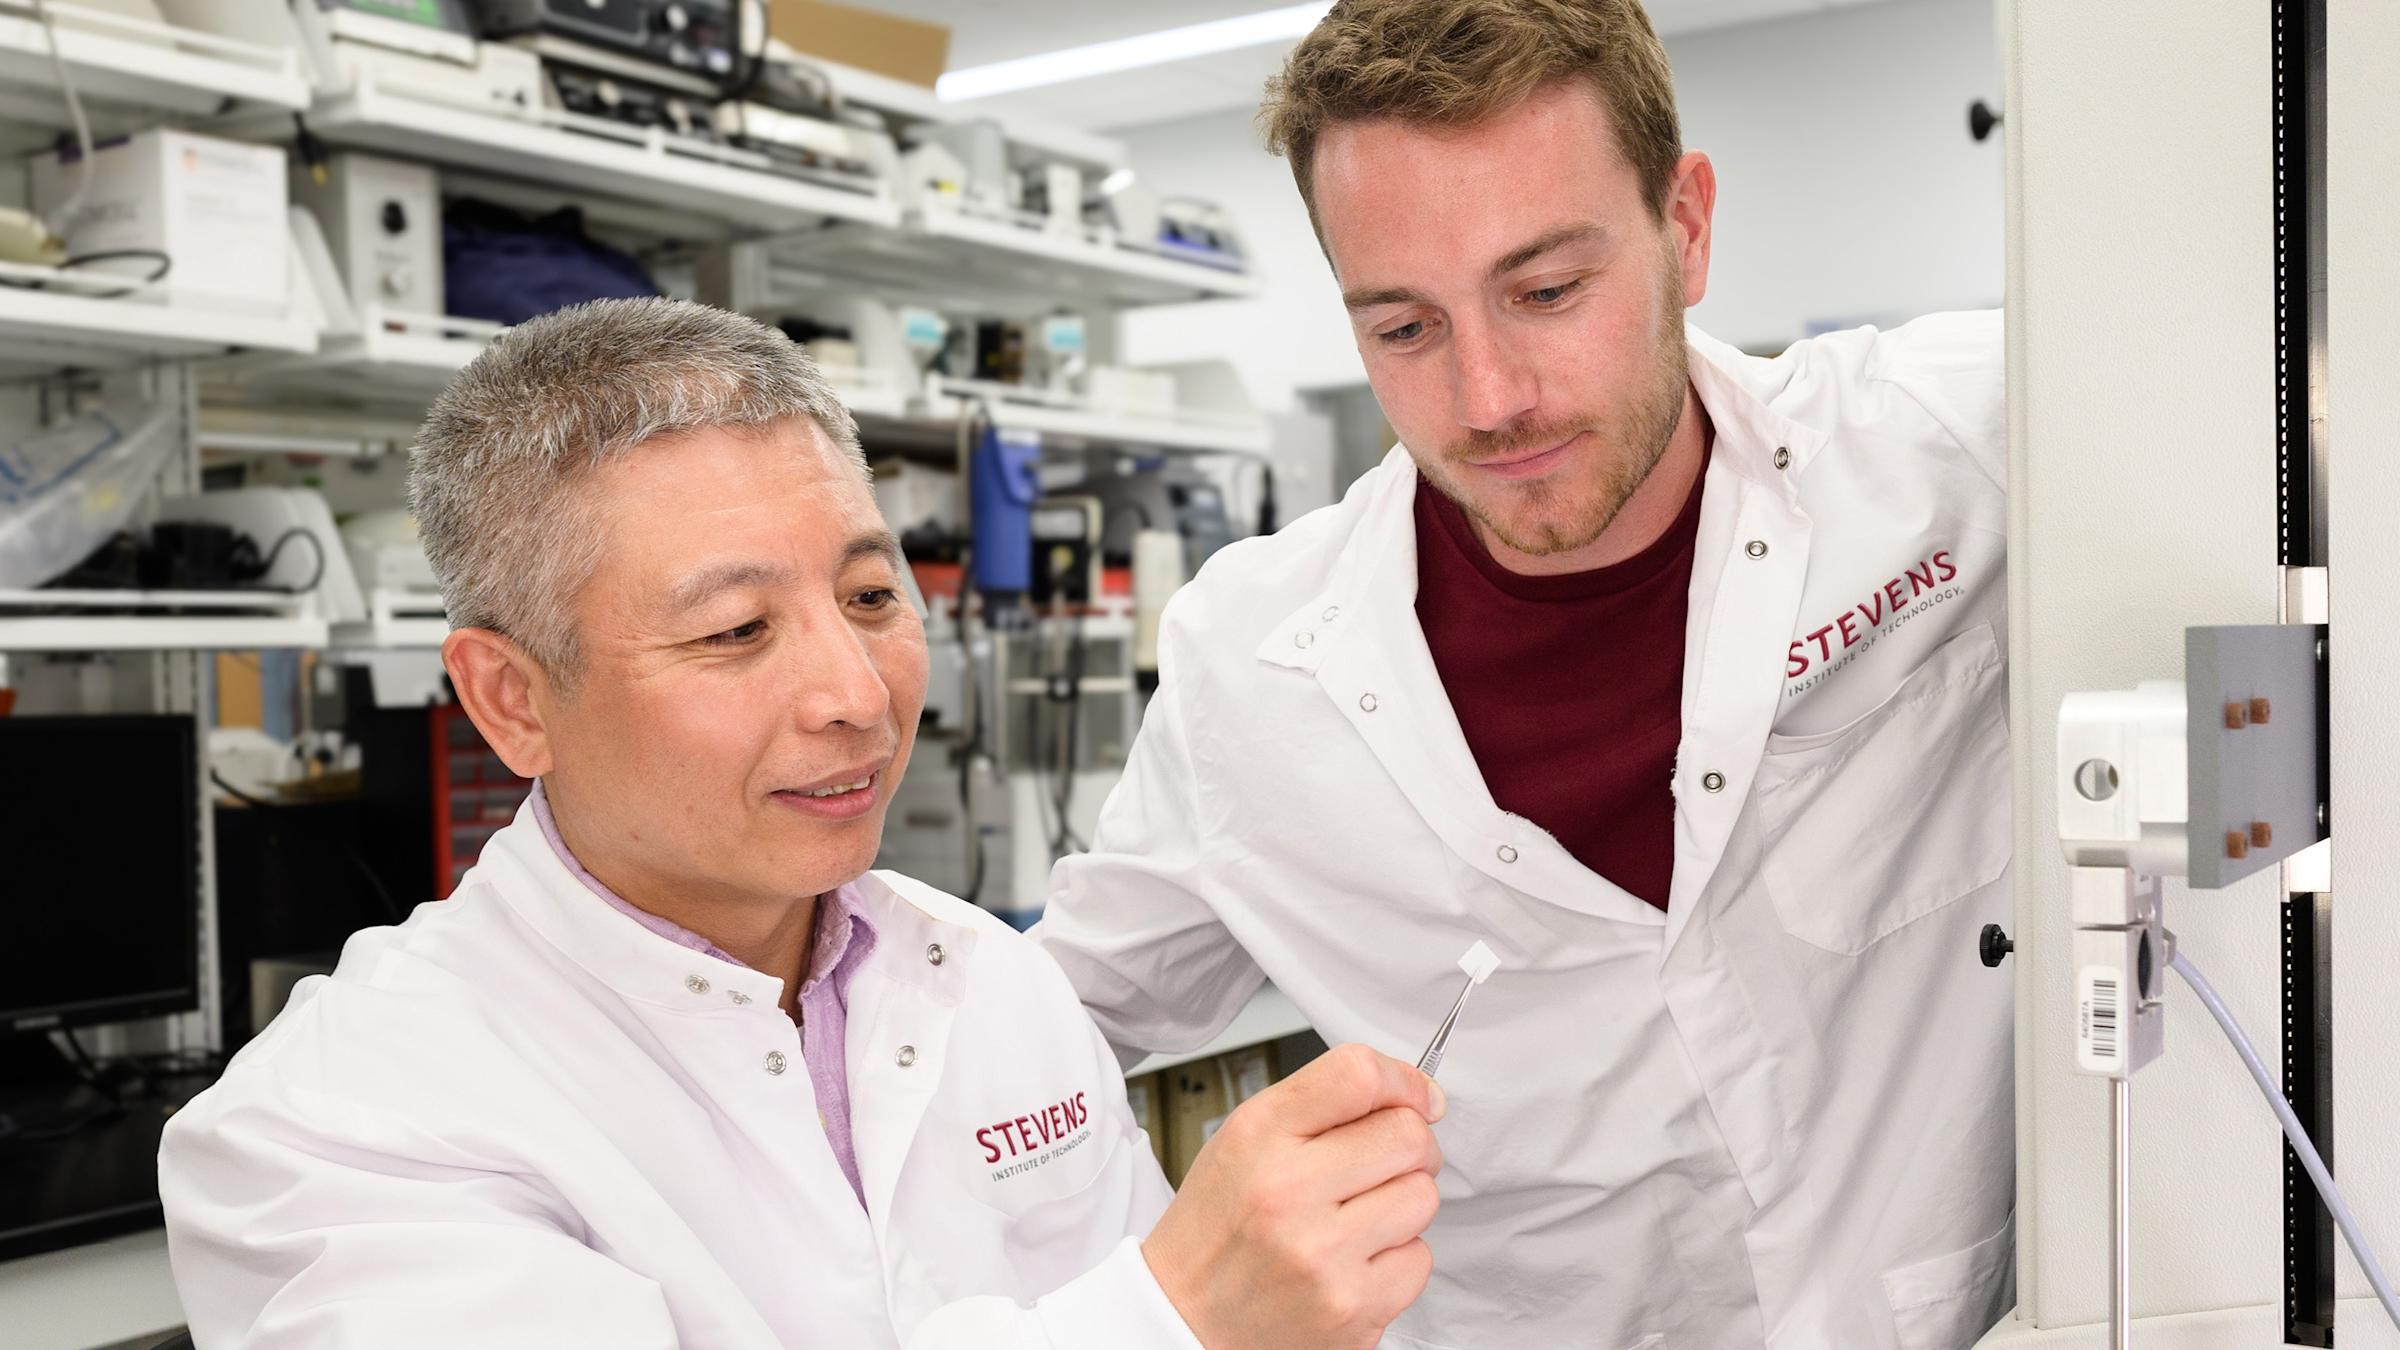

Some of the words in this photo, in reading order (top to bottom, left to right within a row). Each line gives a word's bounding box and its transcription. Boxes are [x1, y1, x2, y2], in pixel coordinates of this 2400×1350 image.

[1787, 550, 1957, 679] STEVENS
[1788, 654, 1857, 697] INSTITUTE
[1861, 636, 1878, 653] OF
[1881, 586, 1962, 638] TECHNOLOGY
[975, 1090, 1087, 1164] STEVENS
[991, 1157, 1039, 1182] INSTITUTE
[1040, 1153, 1050, 1165] OF
